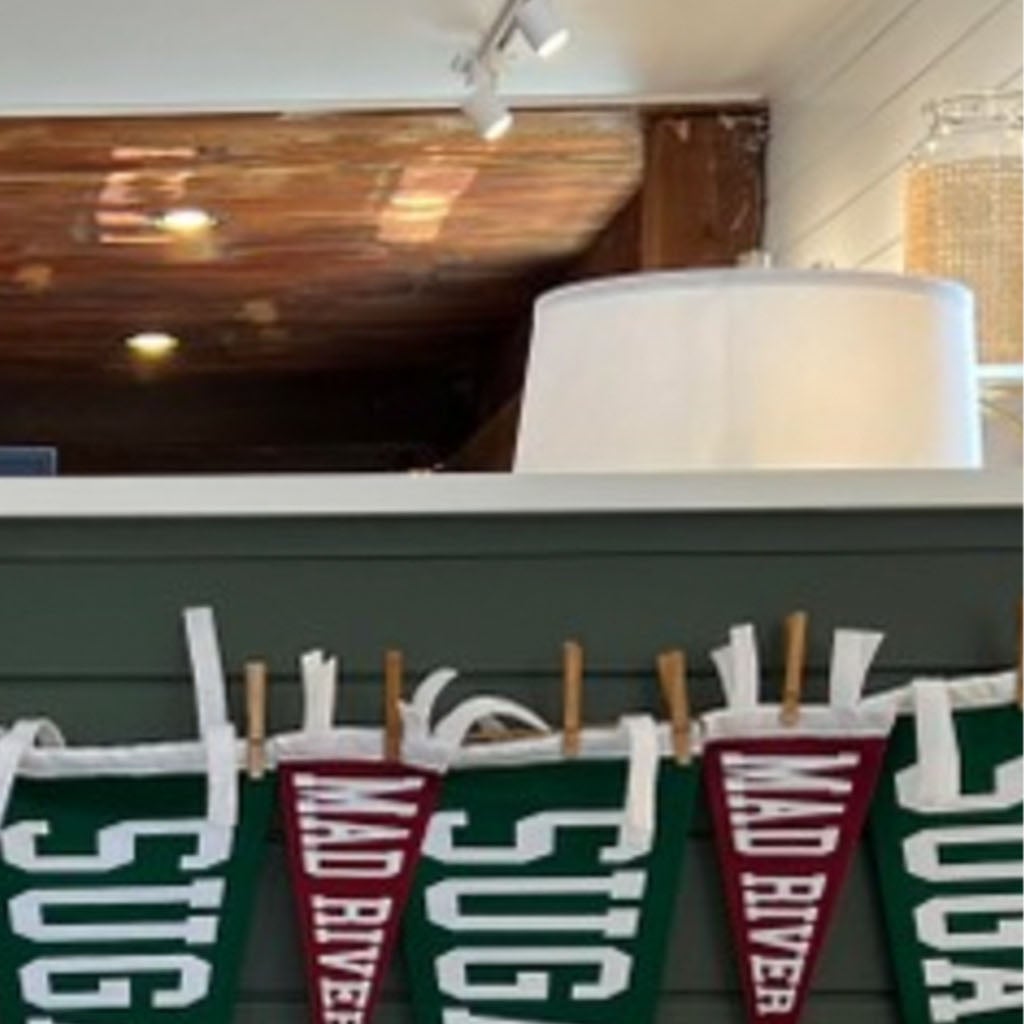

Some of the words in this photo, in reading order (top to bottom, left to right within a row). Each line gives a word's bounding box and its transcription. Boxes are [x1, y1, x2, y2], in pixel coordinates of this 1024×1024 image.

[292, 773, 427, 880] MAD
[721, 751, 861, 858] MAD
[741, 872, 826, 1017] RIVER
